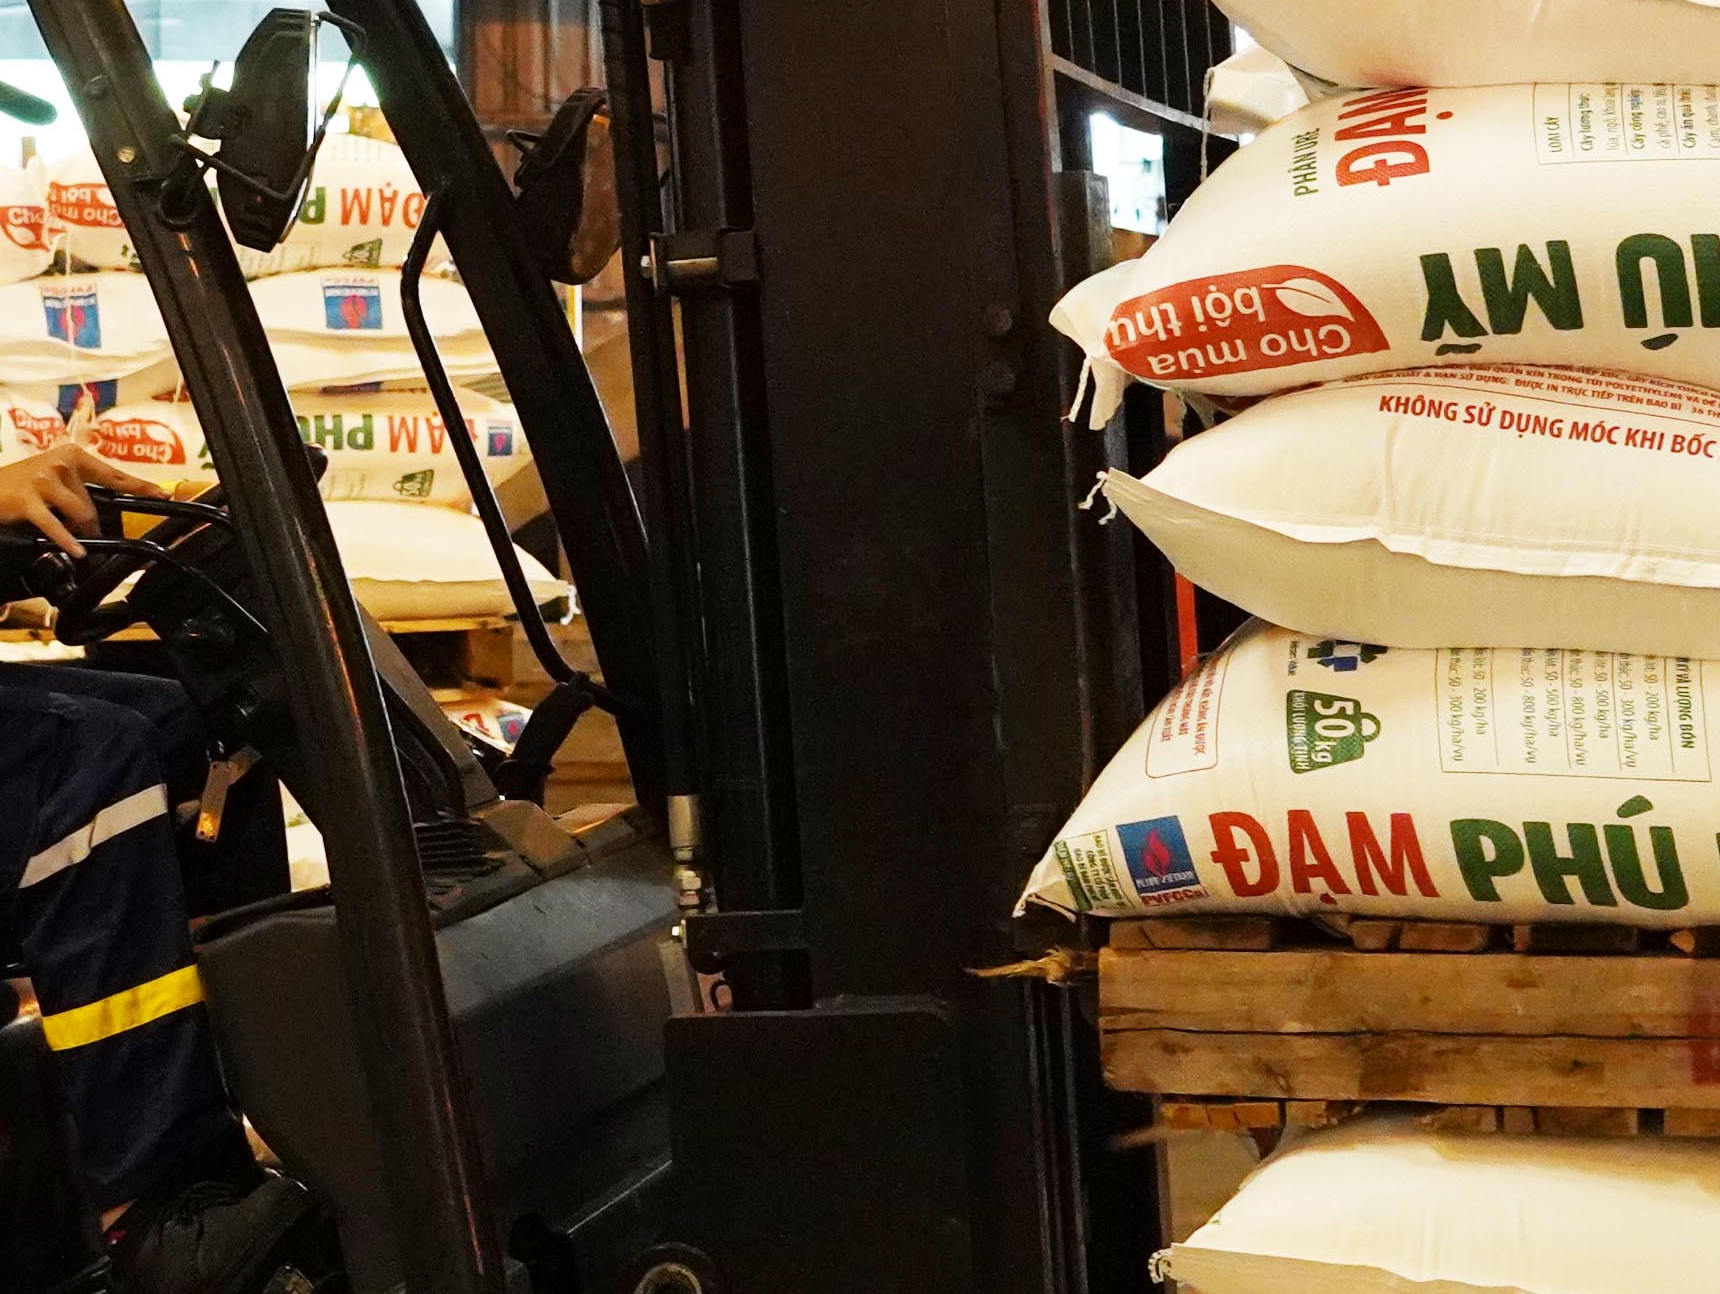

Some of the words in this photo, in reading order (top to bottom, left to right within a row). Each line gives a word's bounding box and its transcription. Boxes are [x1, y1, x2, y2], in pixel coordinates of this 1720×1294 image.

[1191, 284, 1266, 324] bội
[1419, 240, 1585, 357] MỸ
[1147, 333, 1250, 375] mùa
[1259, 322, 1354, 360] Cho
[1380, 395, 1459, 422] KHÔNG
[1464, 405, 1495, 427] SỬ
[1500, 414, 1565, 439] DỤNG
[1569, 419, 1621, 446] MÓC
[1625, 428, 1665, 451] KHI
[1670, 433, 1717, 459] BỐC
[1314, 699, 1356, 738] 50
[1313, 741, 1338, 763] kg
[1206, 809, 1442, 908] ĐẠM
[1449, 795, 1690, 913] PHÚ
